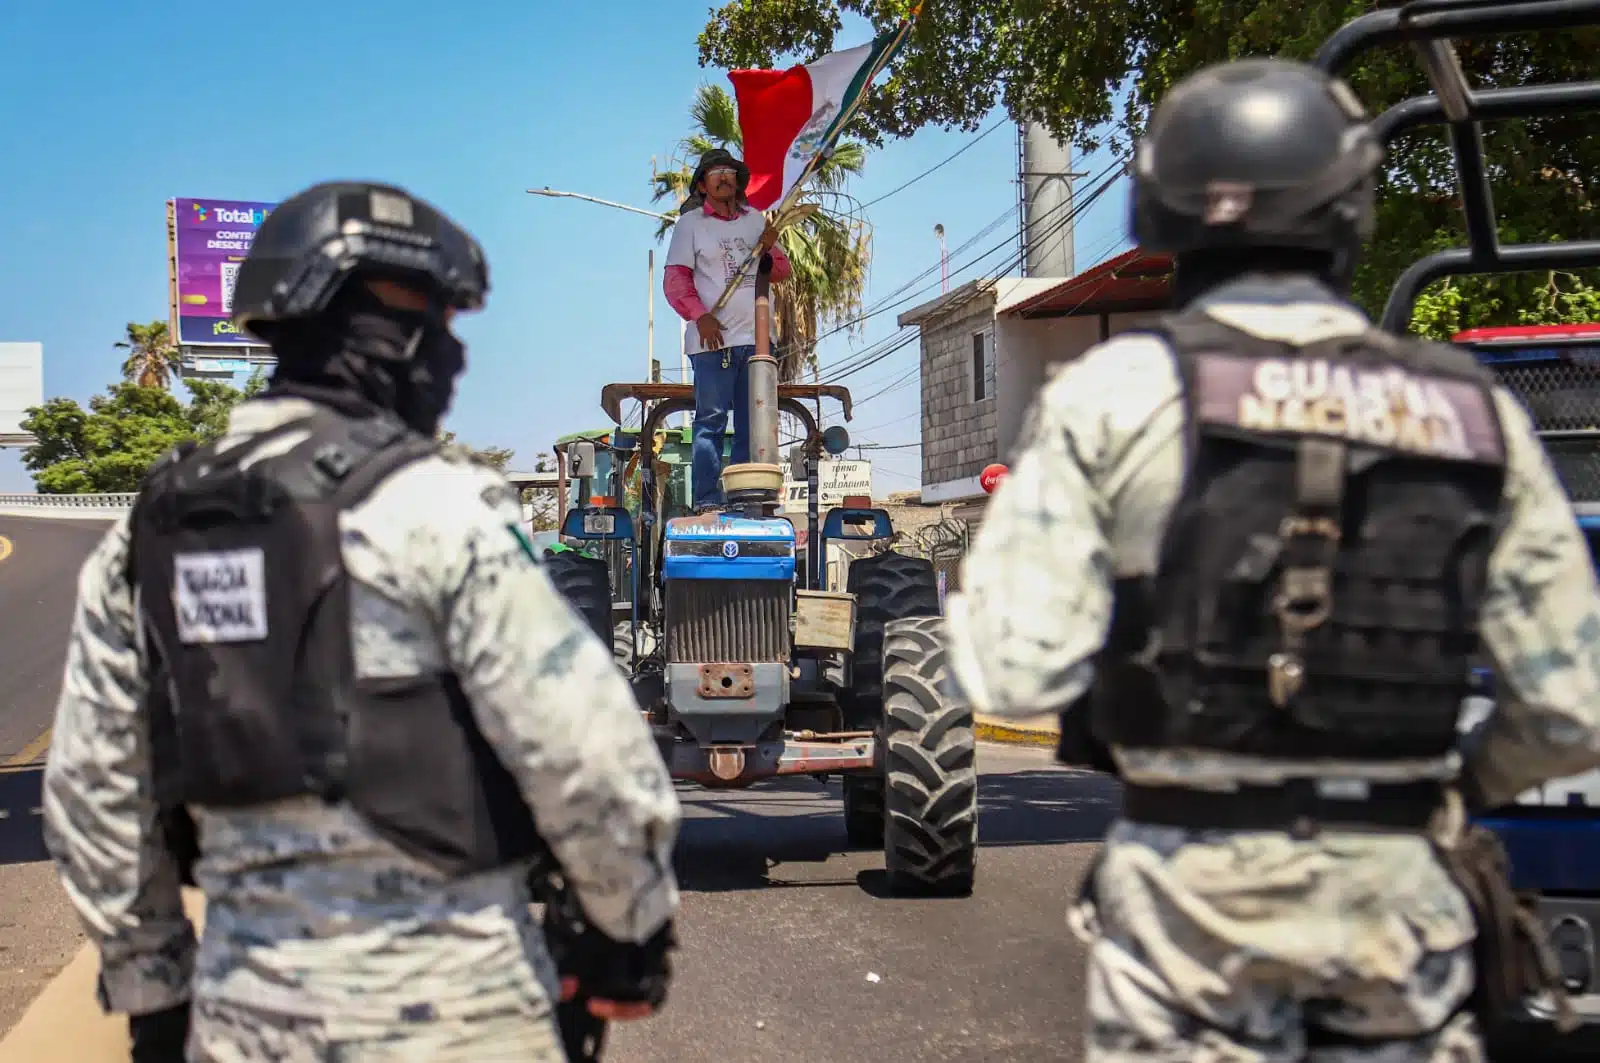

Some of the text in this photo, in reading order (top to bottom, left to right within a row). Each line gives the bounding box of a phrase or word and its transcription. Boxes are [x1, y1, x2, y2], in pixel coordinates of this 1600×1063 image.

[207, 239, 243, 250] DESDE
[832, 464, 857, 473] TORNO
[823, 480, 869, 489] SOLDADURA
